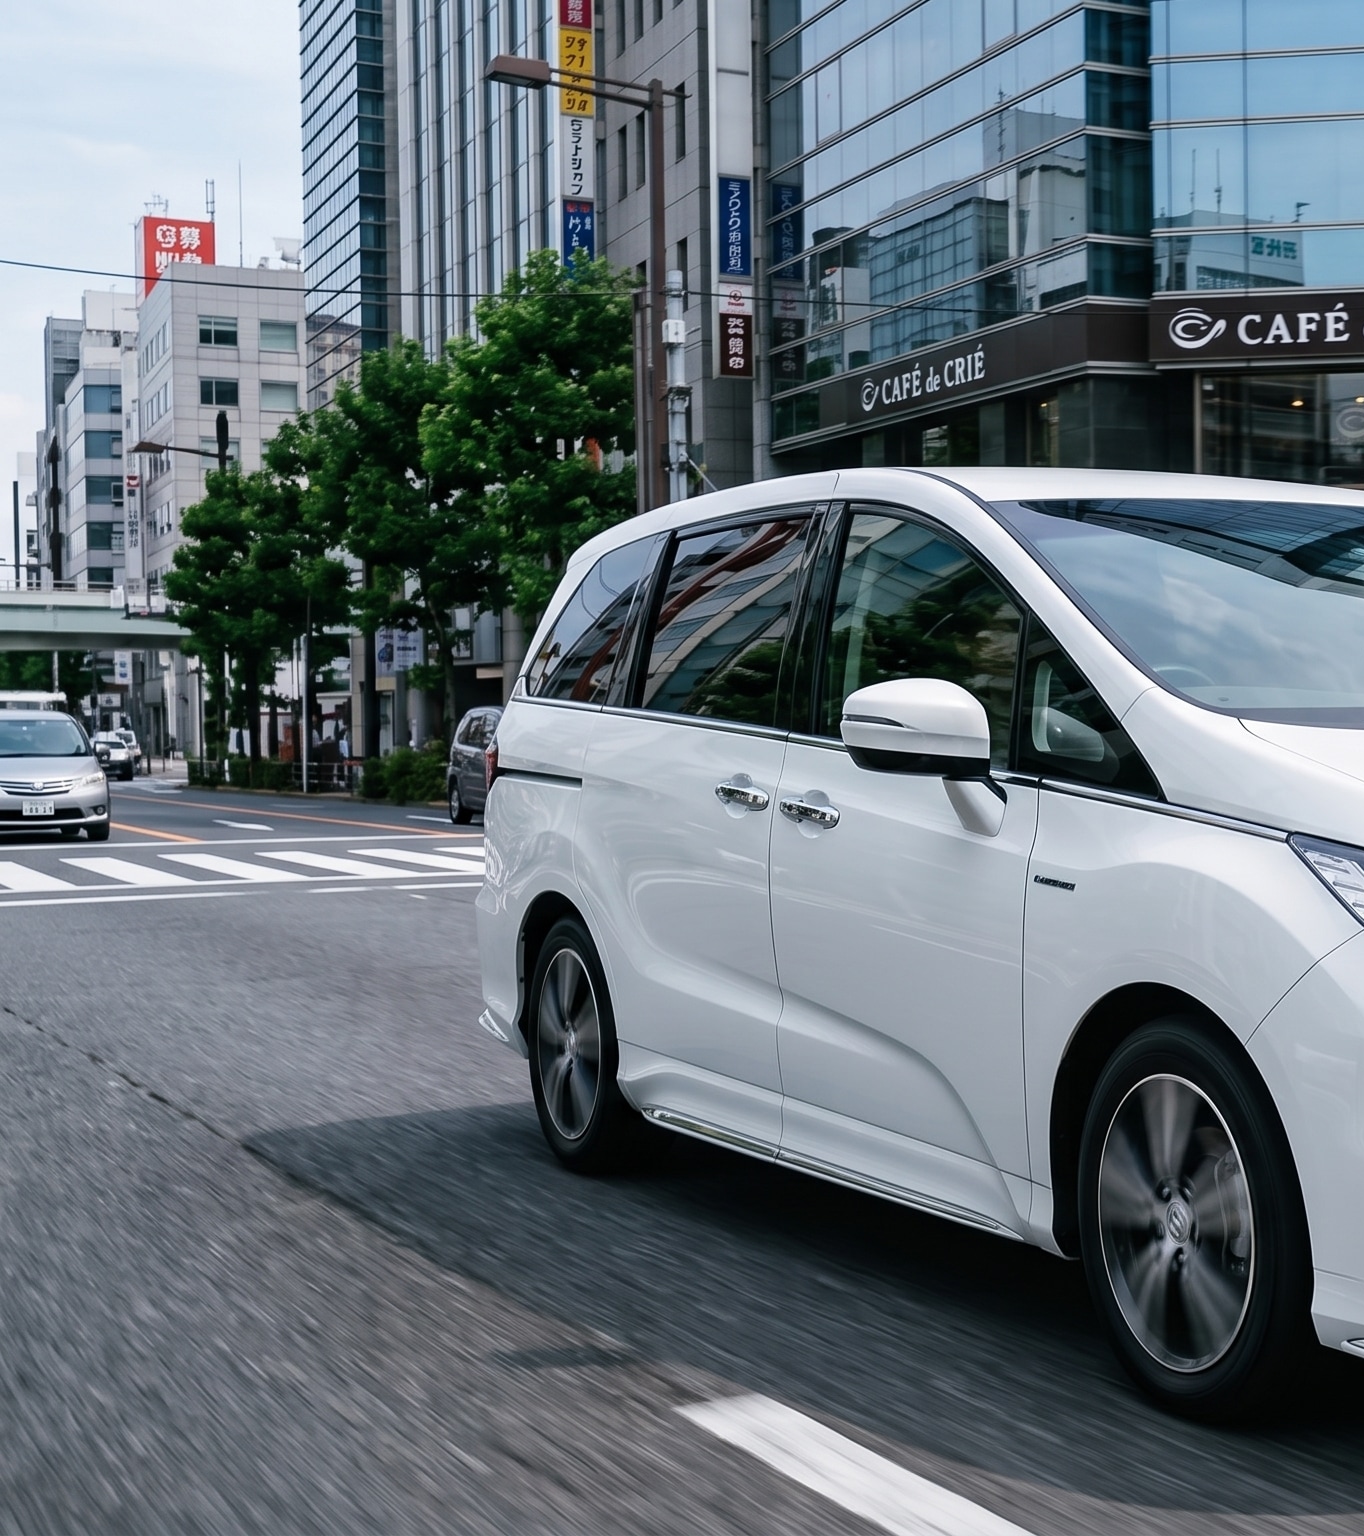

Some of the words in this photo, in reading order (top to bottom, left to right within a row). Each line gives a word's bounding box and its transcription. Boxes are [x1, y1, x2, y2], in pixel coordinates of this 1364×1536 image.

[1237, 302, 1351, 346] CAFÉ
[881, 362, 923, 405] CAFÉ
[925, 366, 941, 393] de
[943, 343, 986, 388] CRIÉ
